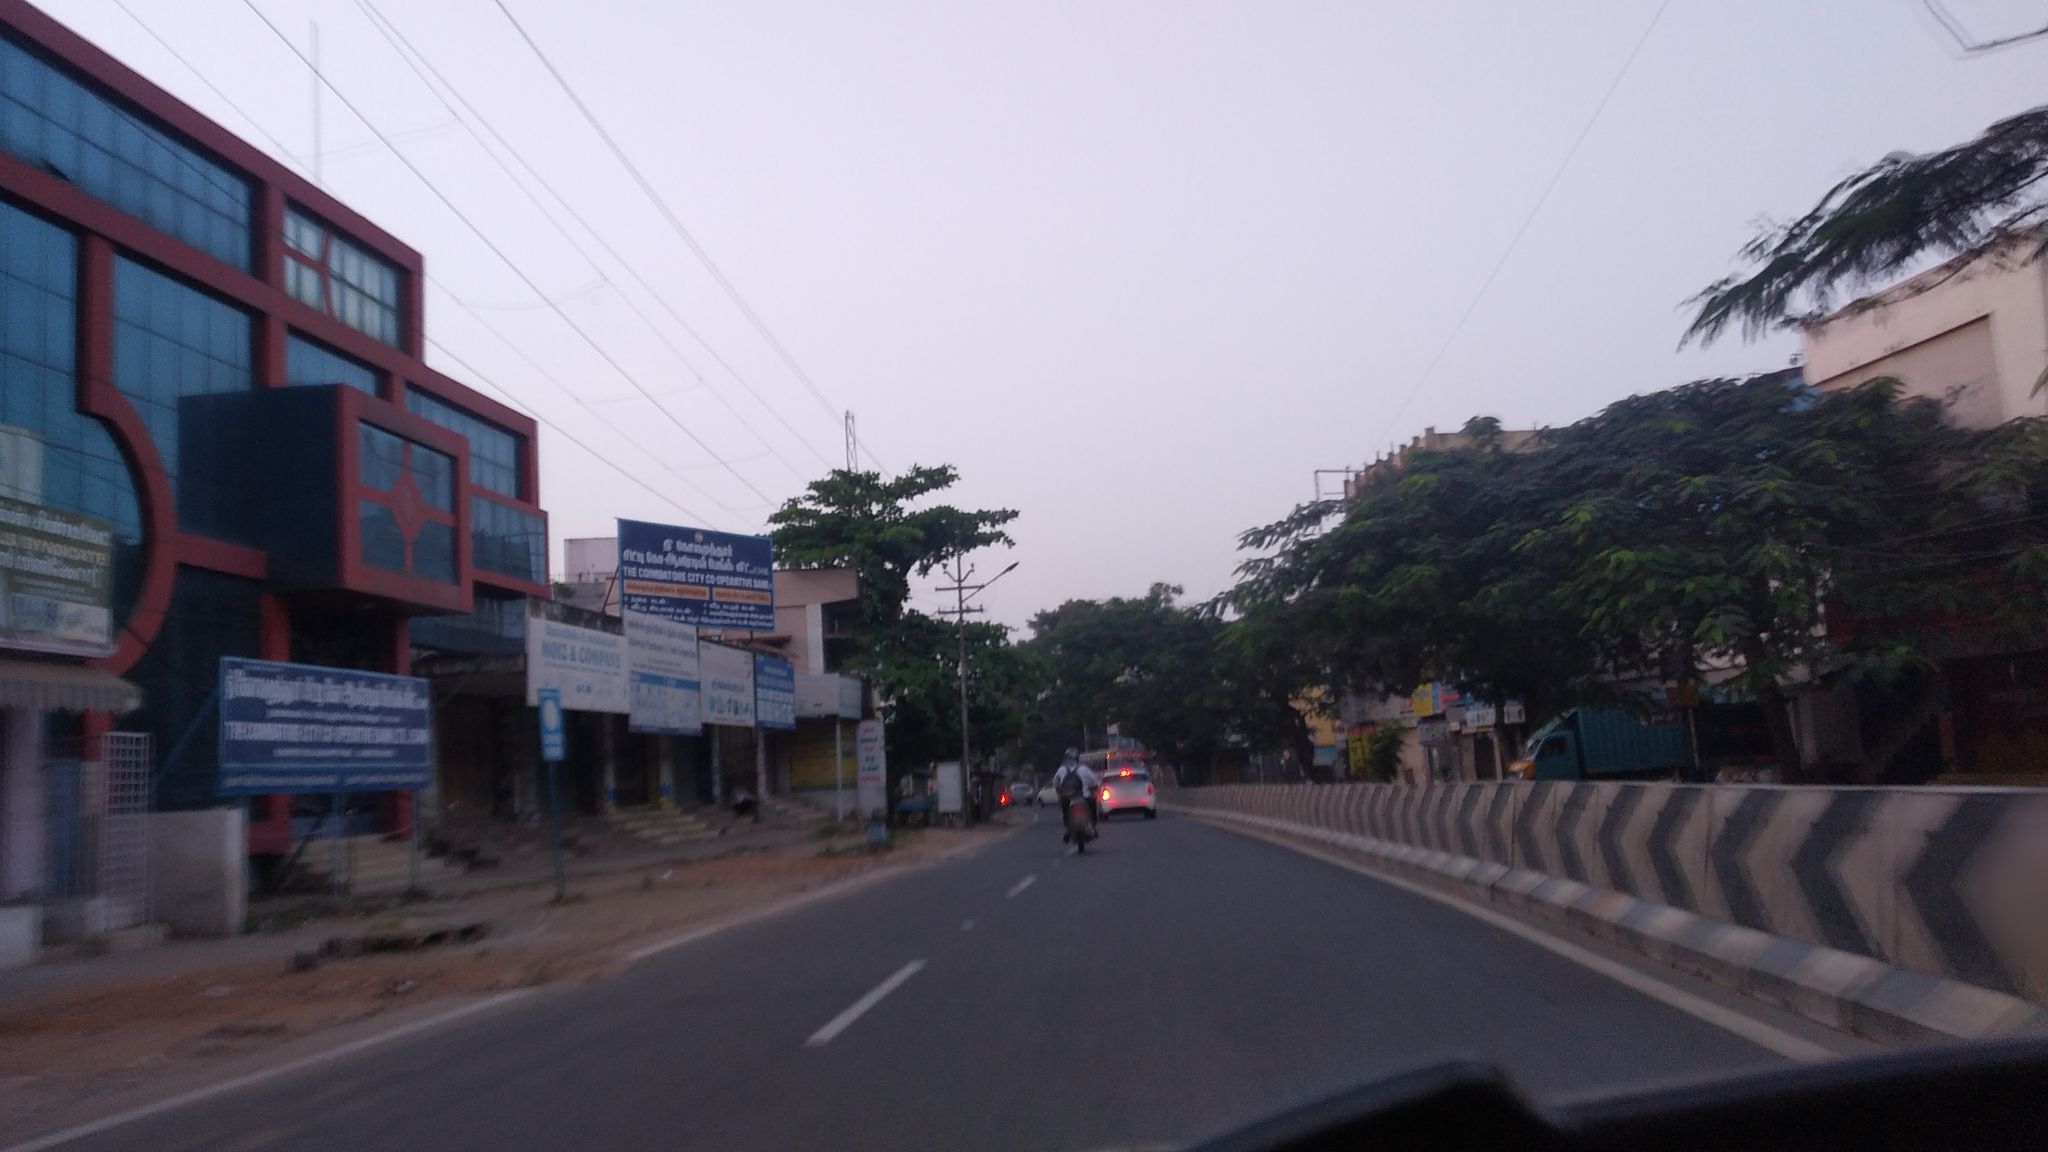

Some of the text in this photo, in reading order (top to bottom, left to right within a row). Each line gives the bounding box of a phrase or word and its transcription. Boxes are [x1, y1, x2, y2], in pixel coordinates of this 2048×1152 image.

[623, 566, 638, 577] THE
[638, 568, 686, 582] COIMBATORE
[687, 573, 705, 584] CITY
